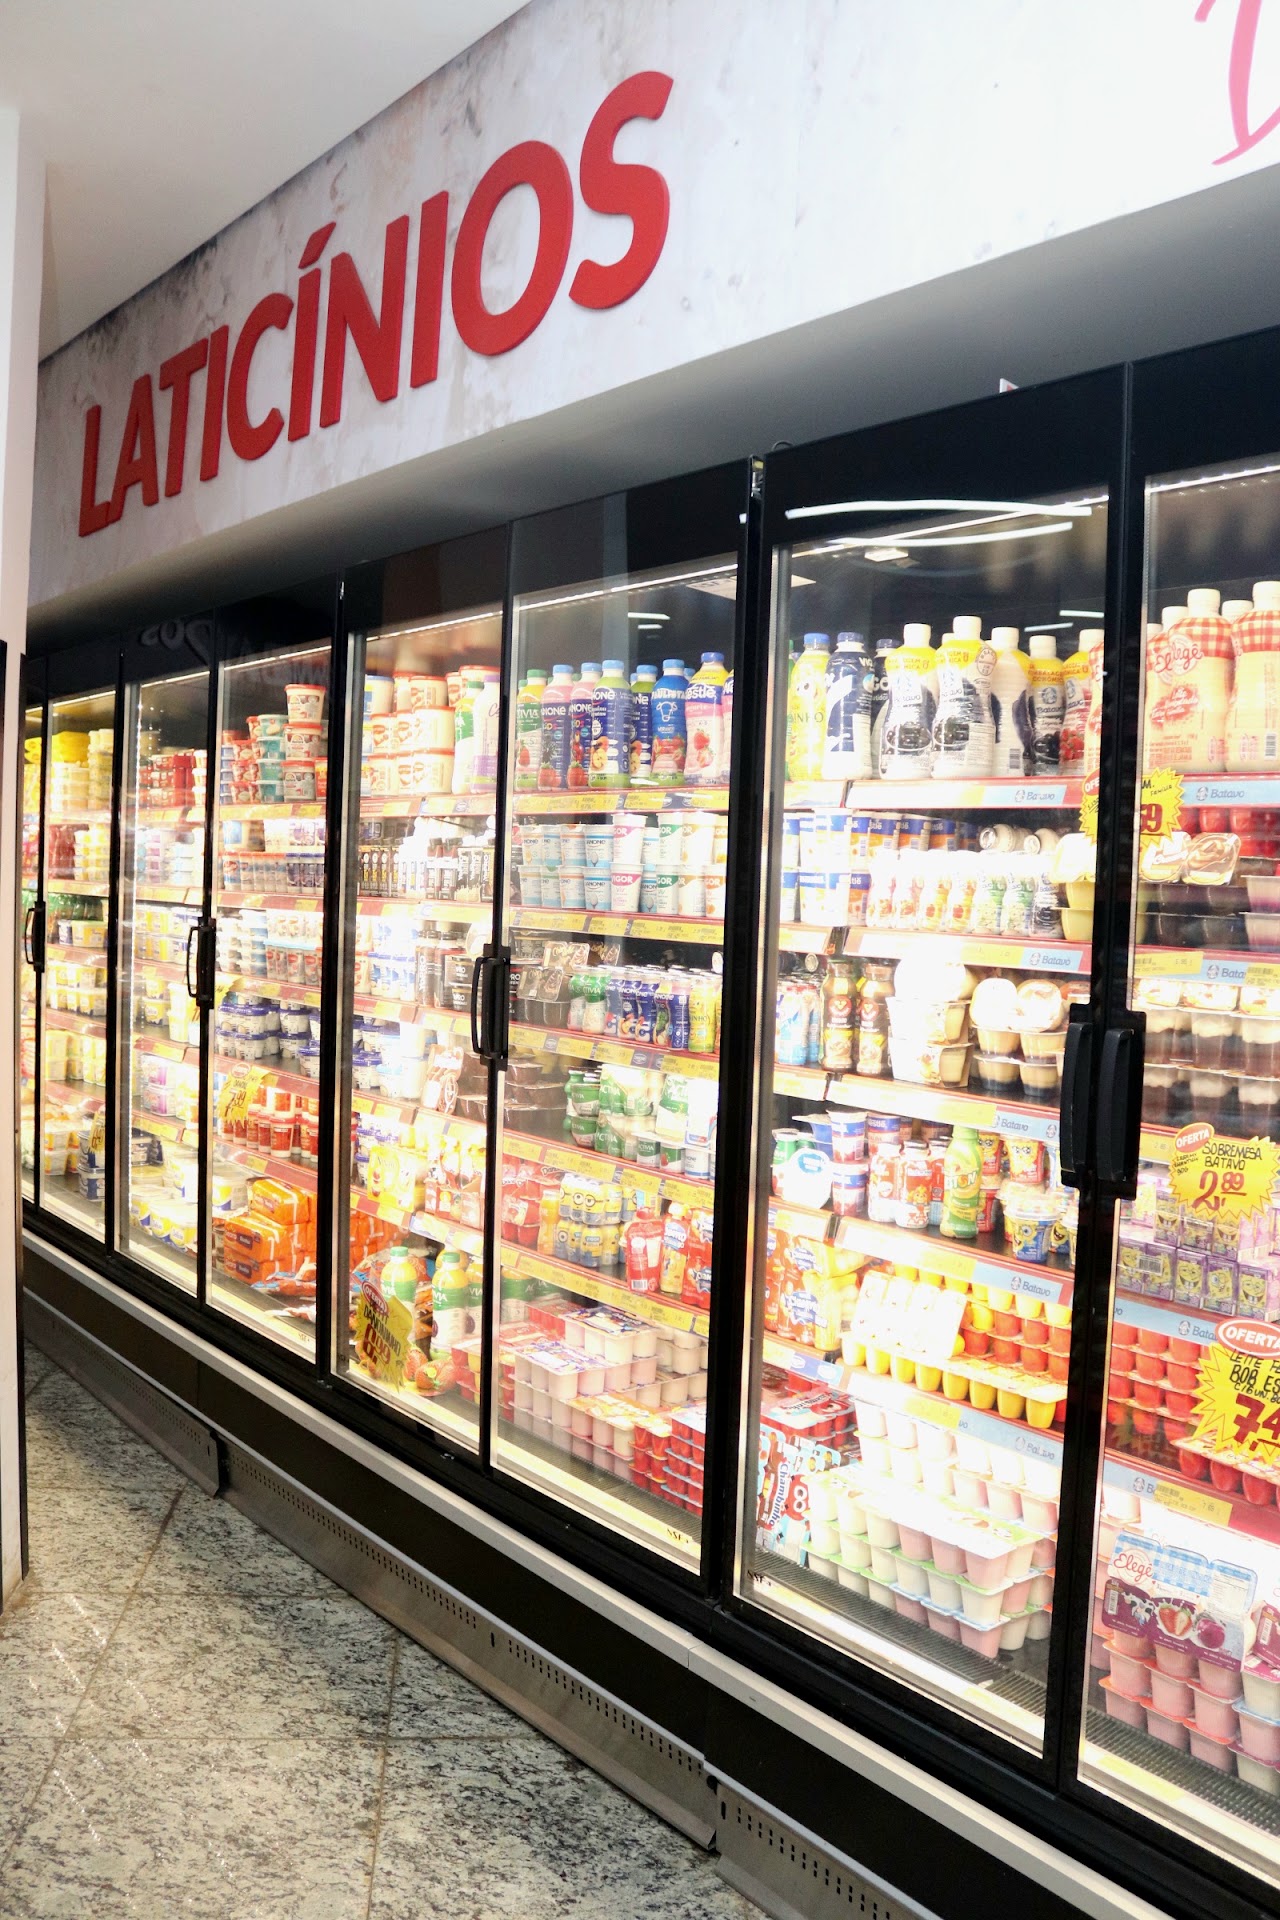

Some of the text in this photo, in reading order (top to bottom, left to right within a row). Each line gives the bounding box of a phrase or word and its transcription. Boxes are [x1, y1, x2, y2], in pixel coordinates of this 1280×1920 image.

[79, 70, 674, 538] LATICÍNIOS
[1210, 790, 1245, 799] Batavo
[1041, 955, 1071, 965] Batavo
[1221, 968, 1246, 979] Bata
[1001, 1119, 1029, 1131] Batavo
[1176, 1128, 1210, 1148] OFERTA
[1202, 1142, 1262, 1160] SOBREMESA
[1205, 1156, 1246, 1171] BATAVO
[1022, 1281, 1051, 1297] Batavo
[1229, 1364, 1259, 1386] BOB
[769, 1462, 789, 1527] Chambinho
